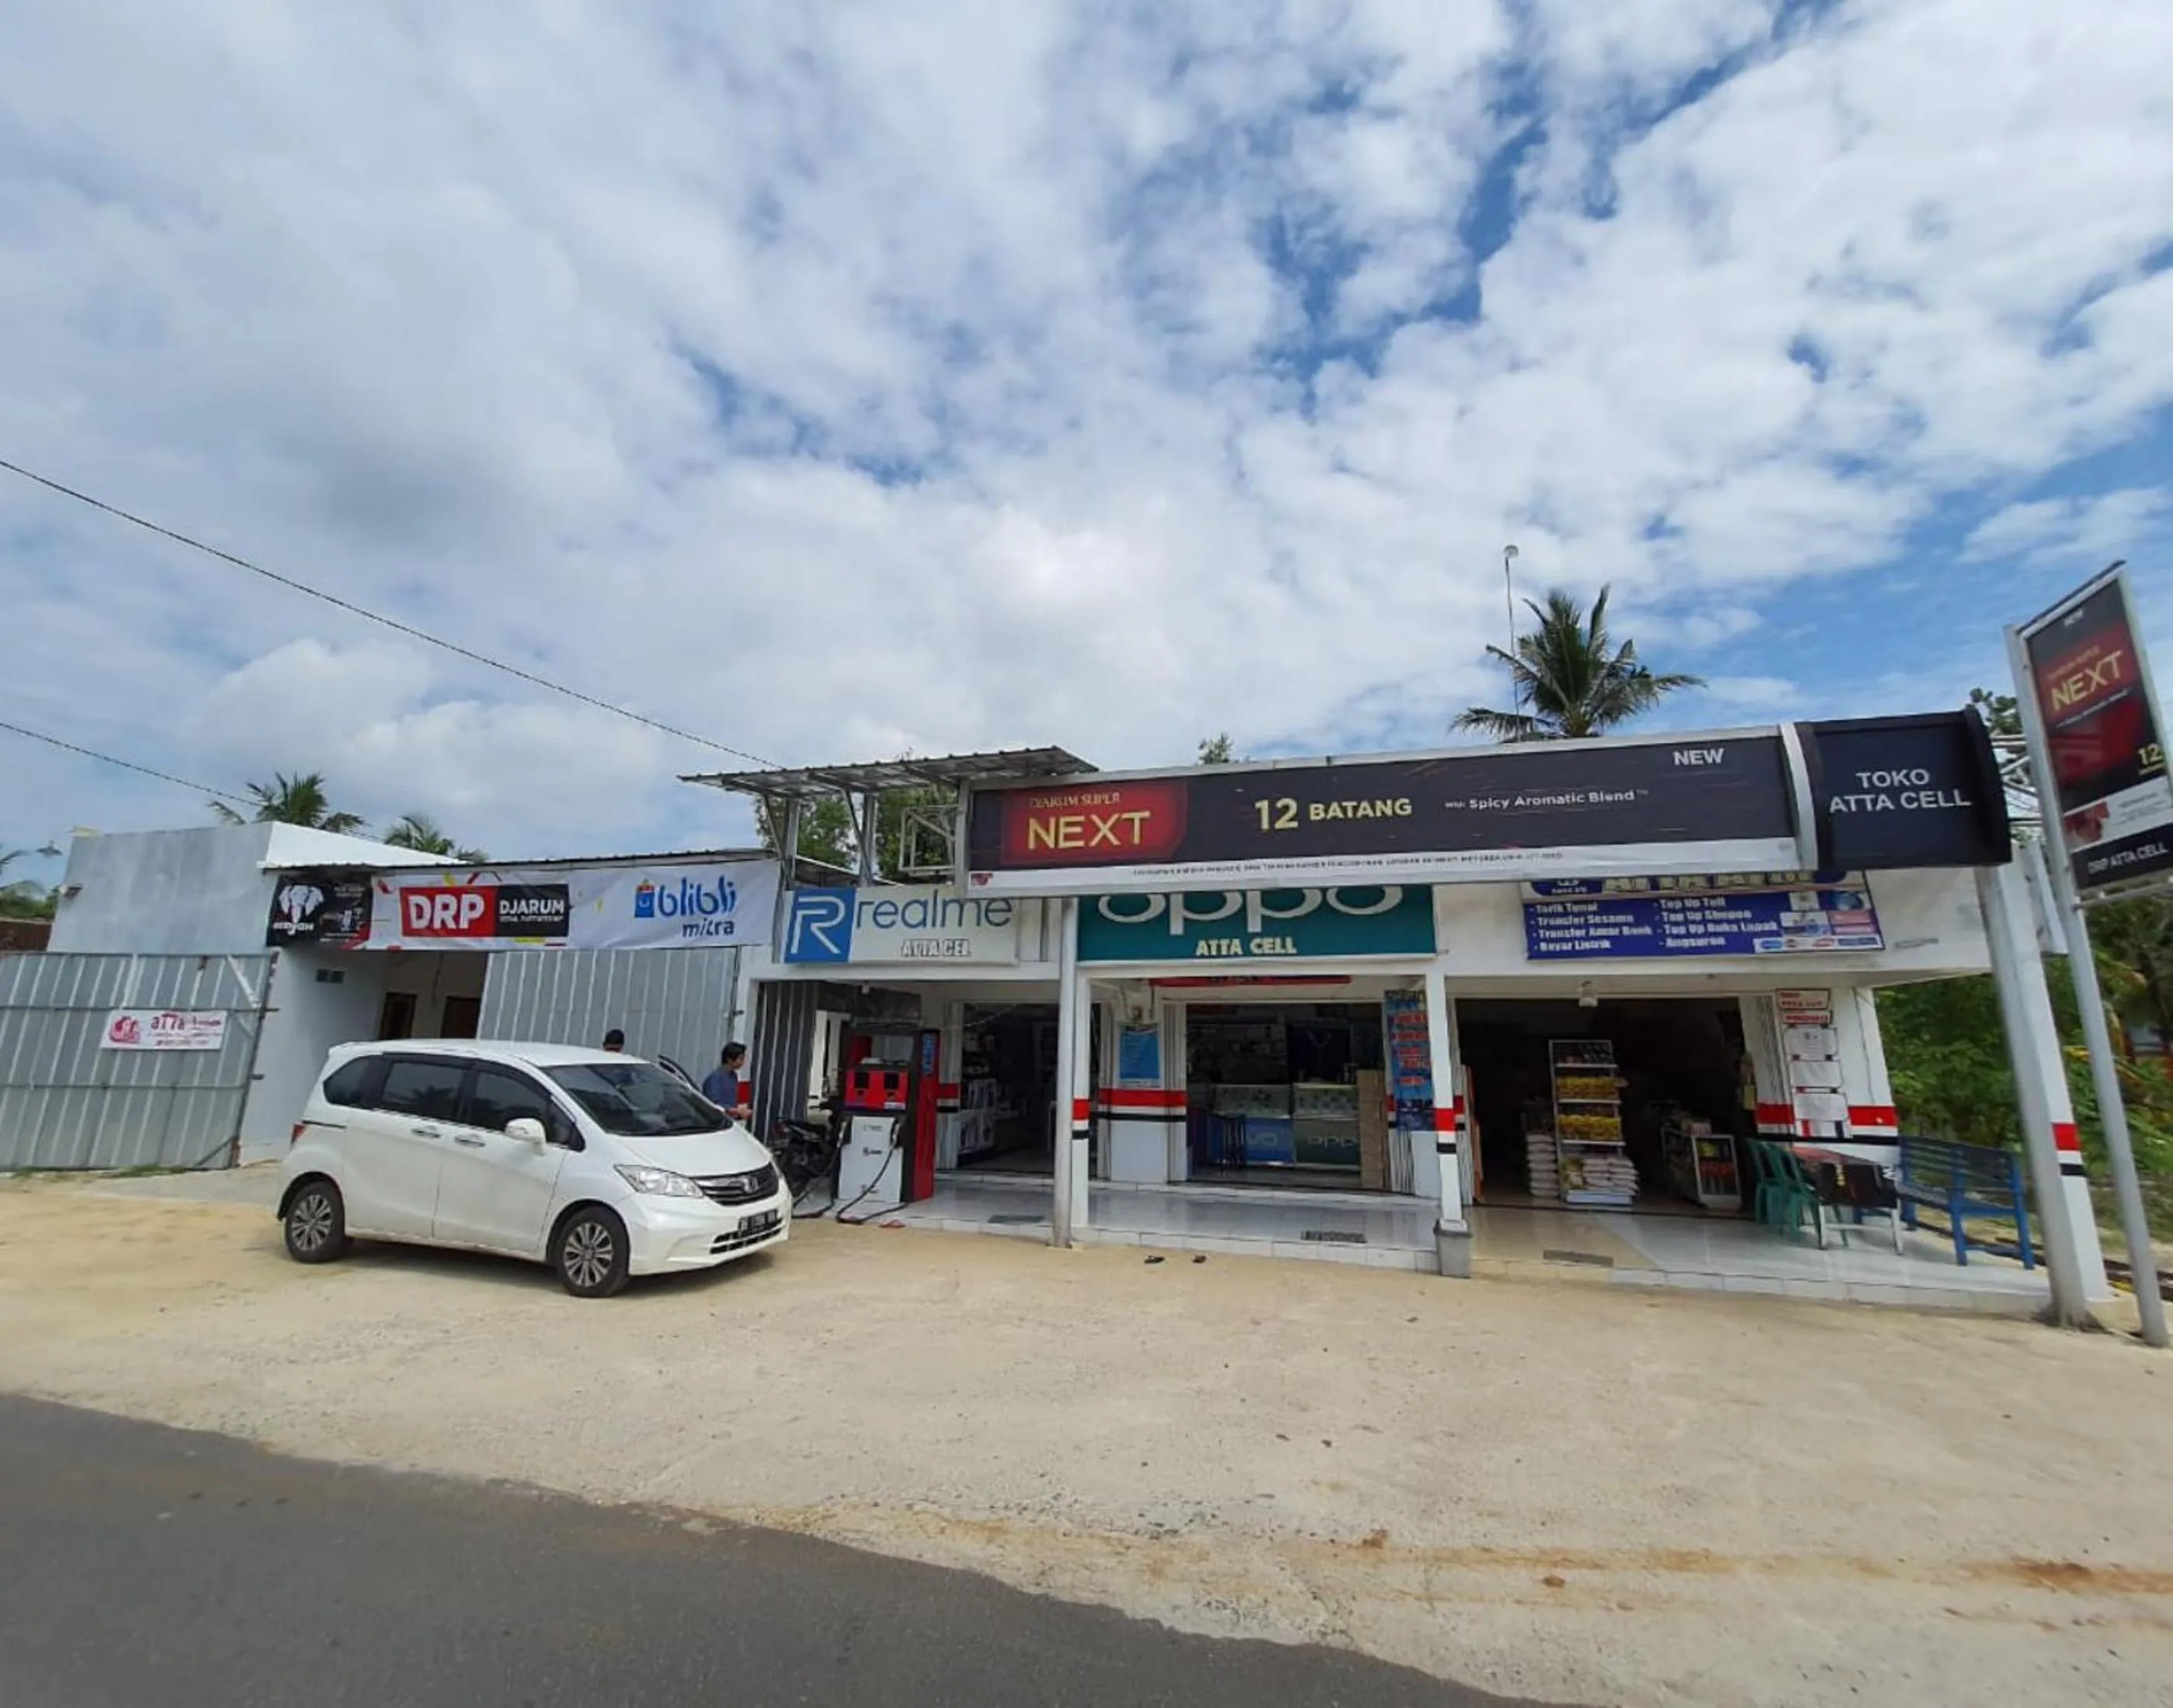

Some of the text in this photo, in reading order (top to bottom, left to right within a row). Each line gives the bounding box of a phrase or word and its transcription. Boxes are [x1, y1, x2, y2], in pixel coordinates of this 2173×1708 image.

[2050, 649, 2123, 711] NEXT
[1673, 748, 1724, 765] NEW
[2137, 742, 2162, 765] 12
[1855, 769, 1930, 789] TOKO
[1469, 797, 1510, 811] Spicy
[1515, 792, 1585, 807] Aromatic
[1588, 789, 1635, 803] Blend
[1829, 789, 1973, 814] ATTA CELL
[1255, 797, 1413, 831] 12 BATANG
[1028, 811, 1151, 850] NEXT
[499, 898, 564, 915] DJARUM
[658, 874, 737, 917] blibli
[408, 894, 485, 929] DRP
[856, 889, 1013, 929] realme
[1098, 884, 1404, 936] oppo
[682, 917, 734, 938] mitra
[1195, 936, 1297, 956] ATTA CELL
